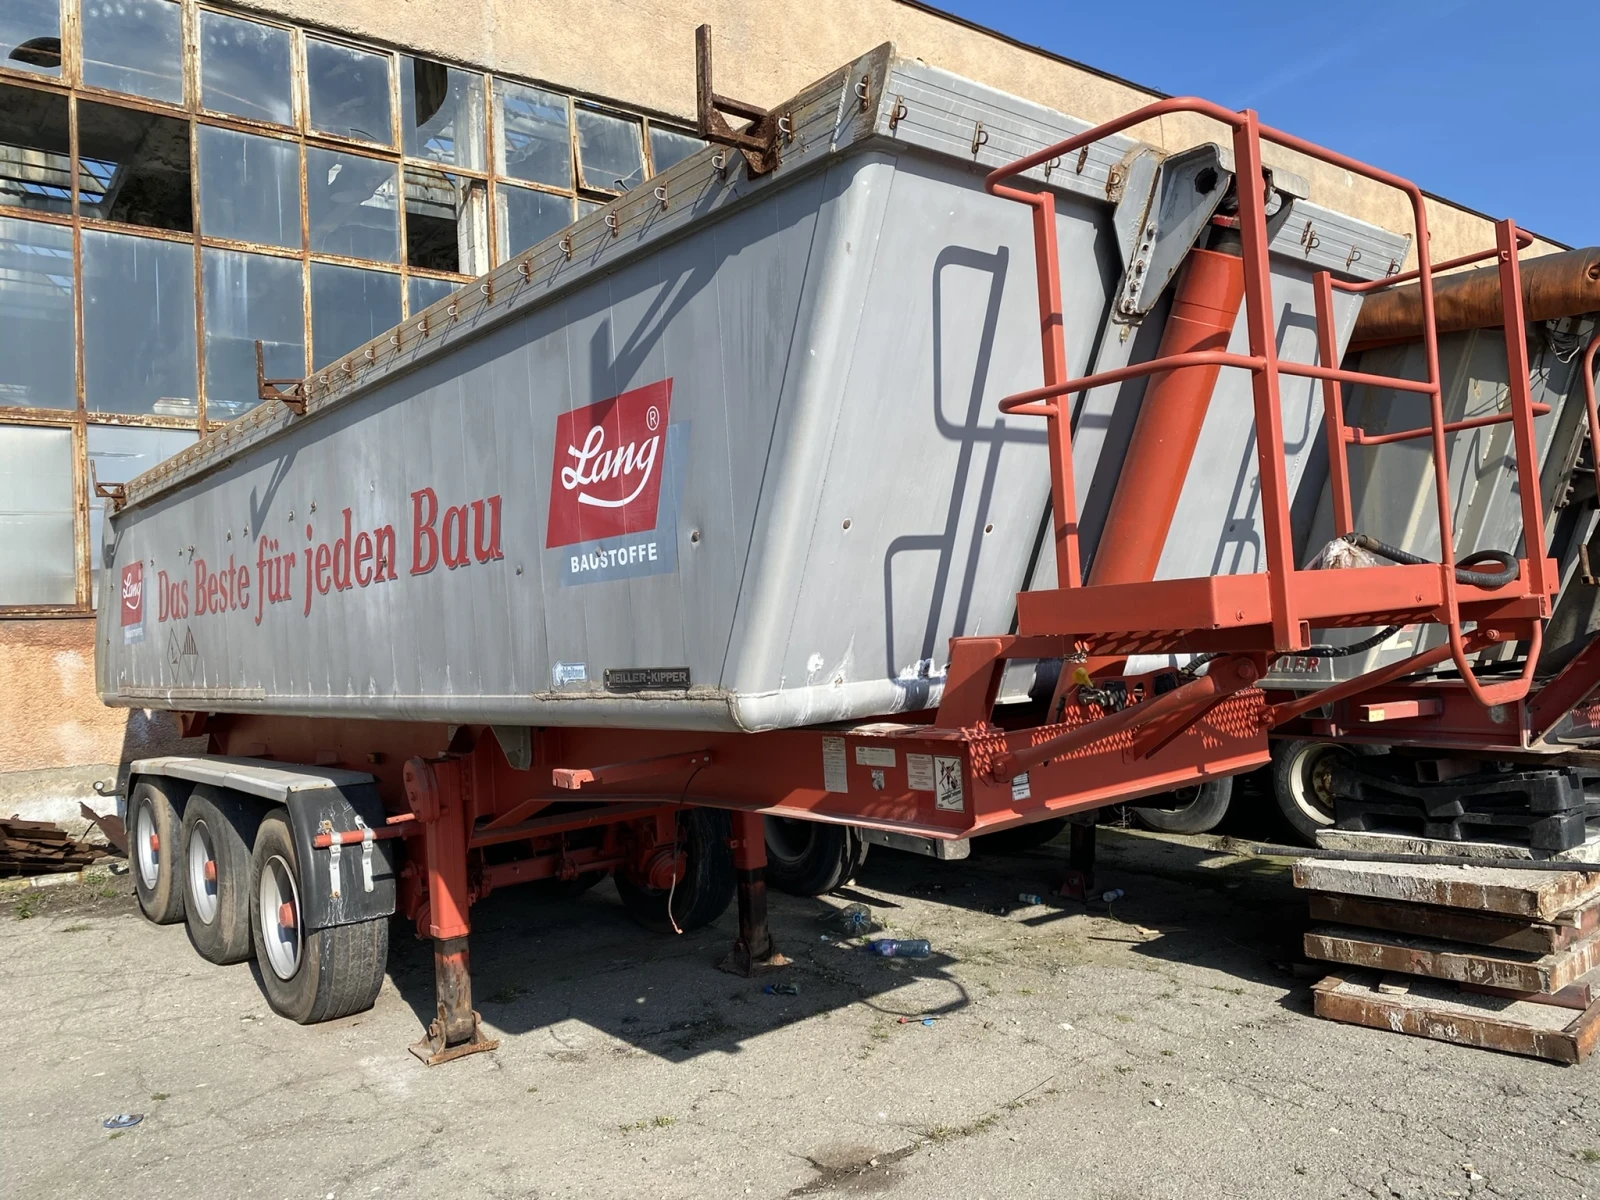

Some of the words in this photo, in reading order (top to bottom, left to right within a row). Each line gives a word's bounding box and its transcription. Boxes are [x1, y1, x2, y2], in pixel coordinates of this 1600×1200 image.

[561, 425, 660, 508] Lang
[157, 570, 189, 623] Das
[194, 554, 250, 616] Beste
[255, 535, 296, 626] für
[304, 507, 398, 618] jeden
[410, 487, 504, 576] Bau
[570, 543, 657, 573] BAUSTOFFE
[122, 573, 142, 610] Lang
[608, 671, 687, 684] MEILLER-KIPPER
[1269, 655, 1320, 673] LLER
